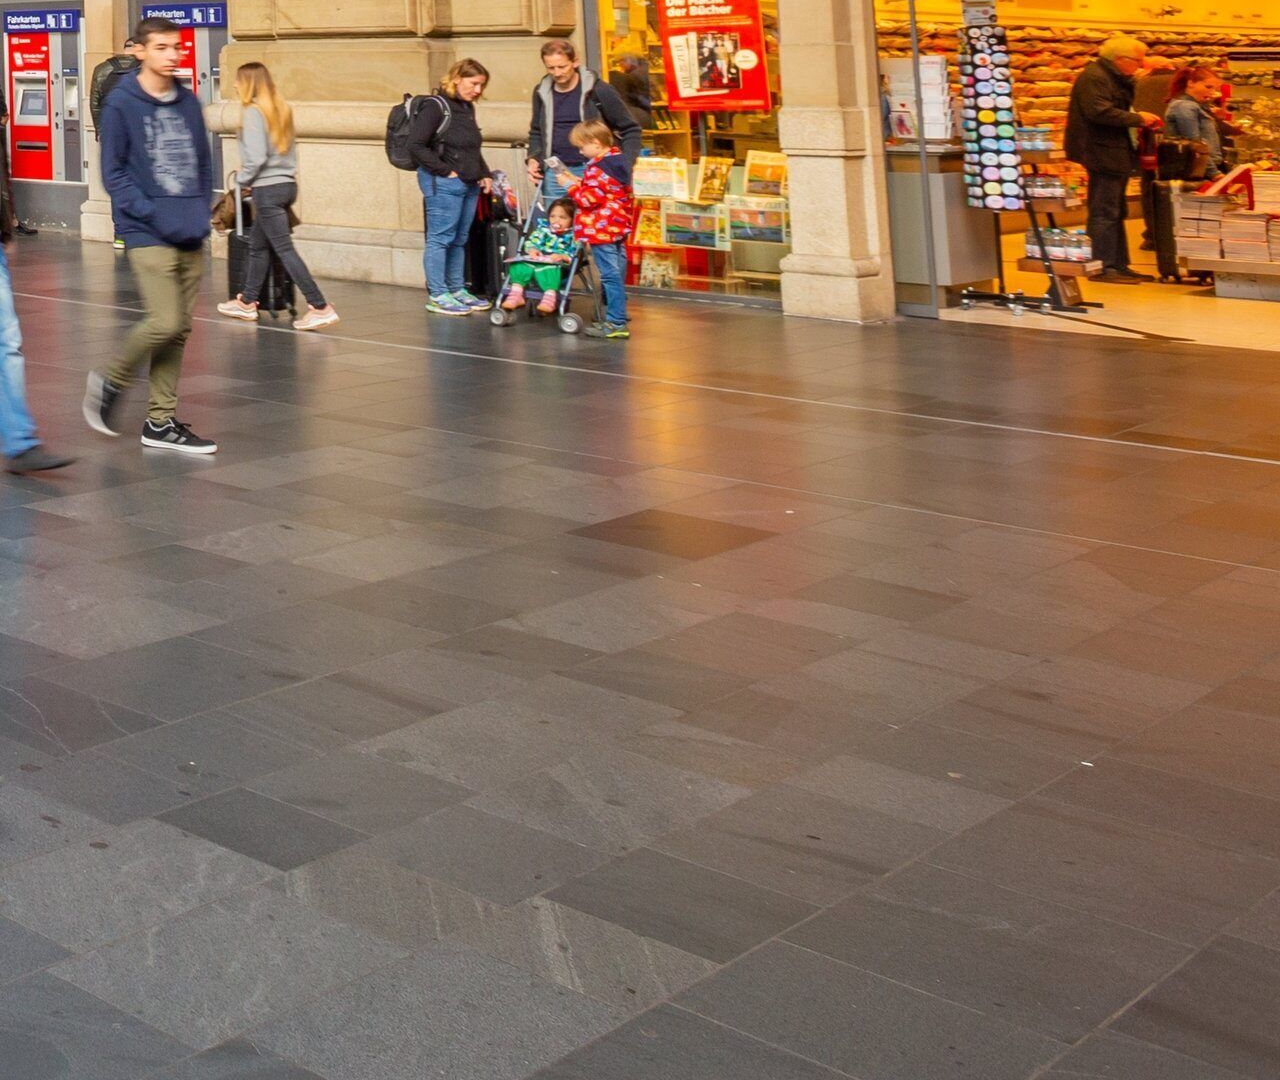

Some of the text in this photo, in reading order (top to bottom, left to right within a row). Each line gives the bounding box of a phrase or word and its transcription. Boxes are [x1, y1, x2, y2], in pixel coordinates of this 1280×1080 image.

[146, 9, 186, 19] Fahrkarten
[666, 4, 733, 17] der Bücher
[6, 15, 40, 24] Fahrkarten
